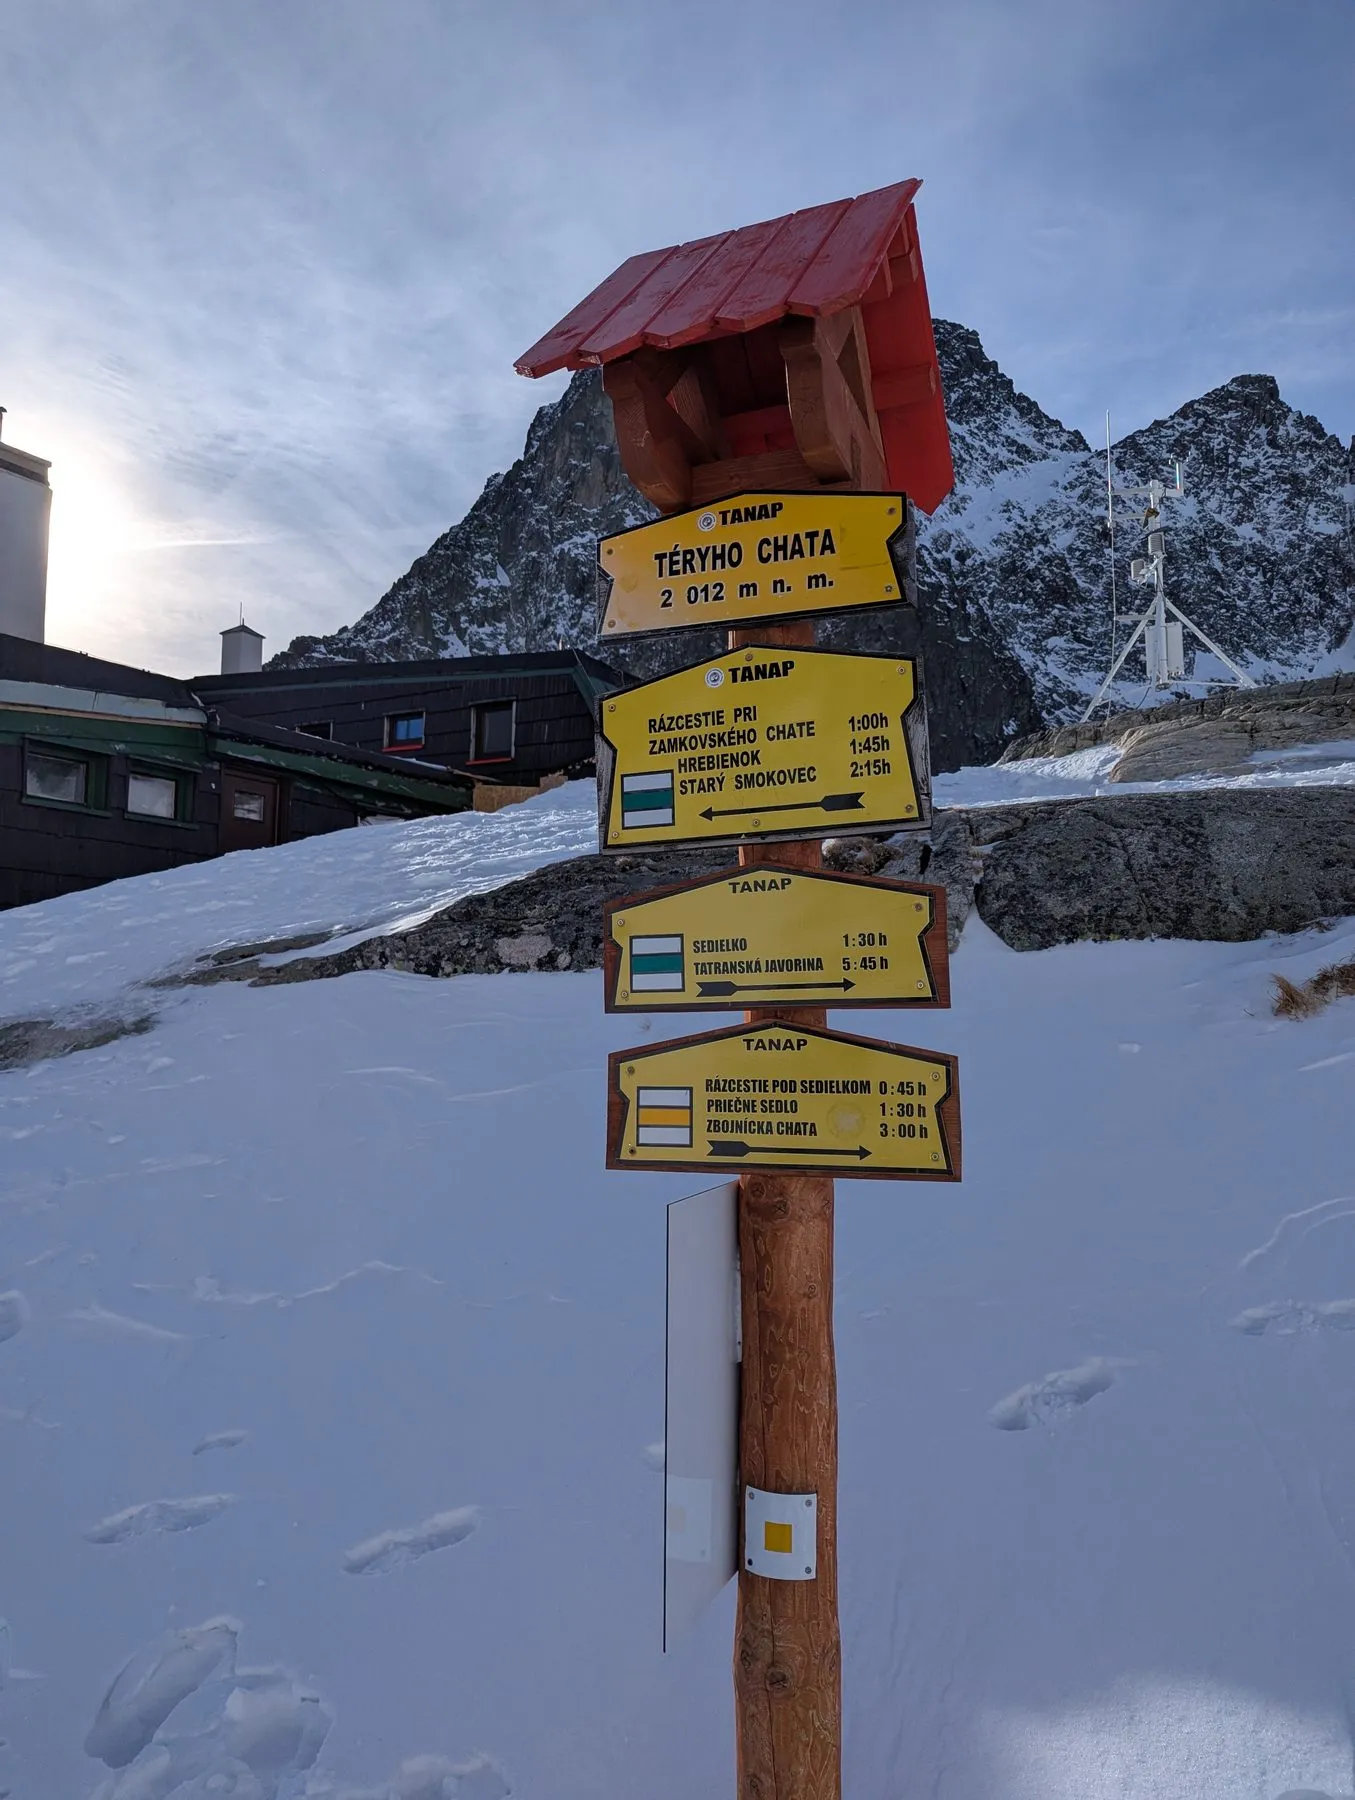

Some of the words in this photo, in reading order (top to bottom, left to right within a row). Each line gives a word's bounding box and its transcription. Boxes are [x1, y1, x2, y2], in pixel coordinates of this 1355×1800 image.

[719, 502, 783, 526] TANAP
[654, 542, 743, 578] TÉRYHO
[758, 529, 835, 563] CHATA
[660, 589, 673, 608] 2
[687, 583, 724, 605] 012
[739, 582, 758, 597] m
[772, 577, 791, 594] n.
[807, 572, 833, 589] m.
[729, 661, 795, 684] TANAP
[648, 709, 725, 734] RÁZCESTIE
[734, 706, 757, 723] PRI
[848, 713, 888, 732] 1:00h
[649, 727, 757, 755] ZAMKOVSKÉHO
[766, 721, 815, 741] CHATE
[849, 736, 890, 755] 1:45h
[678, 750, 761, 773] HREBIENOK
[850, 759, 891, 778] 2:15h
[680, 772, 726, 795] STARÝ
[735, 766, 817, 790] SMOKOVEC
[729, 878, 791, 894] TANAP
[693, 938, 748, 954] SEDIELKO
[693, 957, 762, 975] TATRANSKÁ
[764, 958, 823, 973] JAVORINA
[743, 1038, 808, 1051] TANAP
[705, 1075, 769, 1093] RÁZCESTIE
[772, 1080, 798, 1093] POD
[800, 1080, 870, 1094] SEDIELKOM
[707, 1096, 758, 1113] PRIEČNE
[760, 1100, 798, 1113] SEDLO
[706, 1117, 773, 1134] ZBOJNÍCKA
[776, 1122, 817, 1137] CHATA
